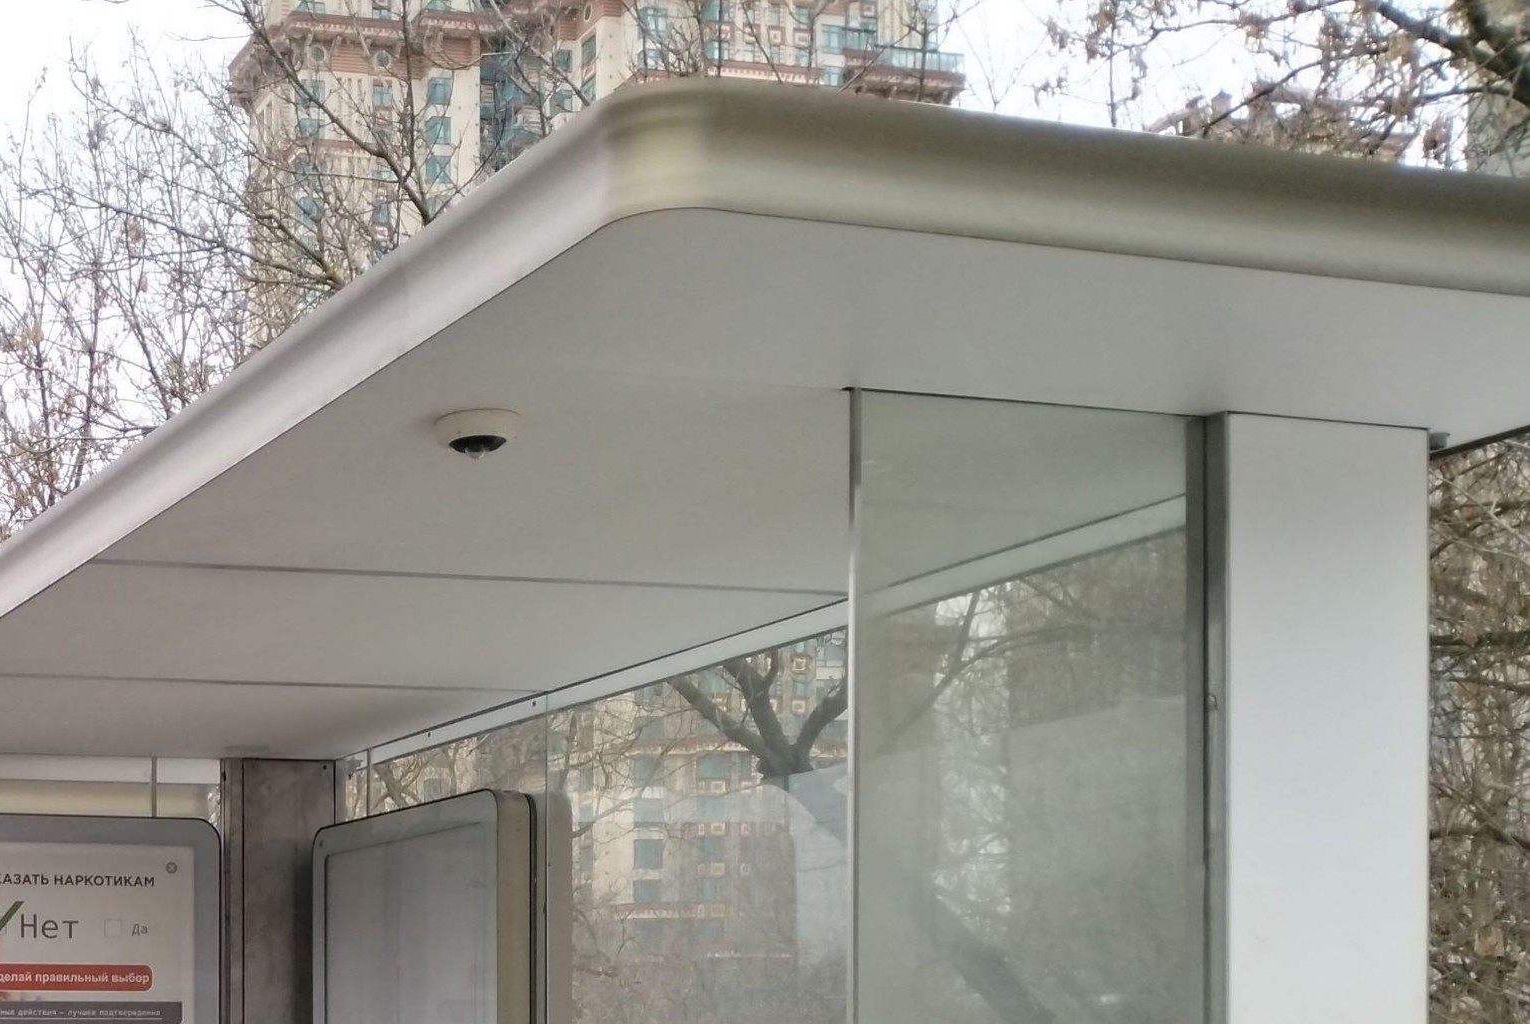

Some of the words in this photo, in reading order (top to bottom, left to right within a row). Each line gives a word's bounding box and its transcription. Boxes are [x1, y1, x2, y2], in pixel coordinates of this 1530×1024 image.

[53, 875, 155, 887] НАРКОТИКАМ
[20, 913, 79, 940] Нет
[131, 922, 149, 937] Да
[35, 971, 109, 985] правильный
[111, 972, 150, 985] выбор
